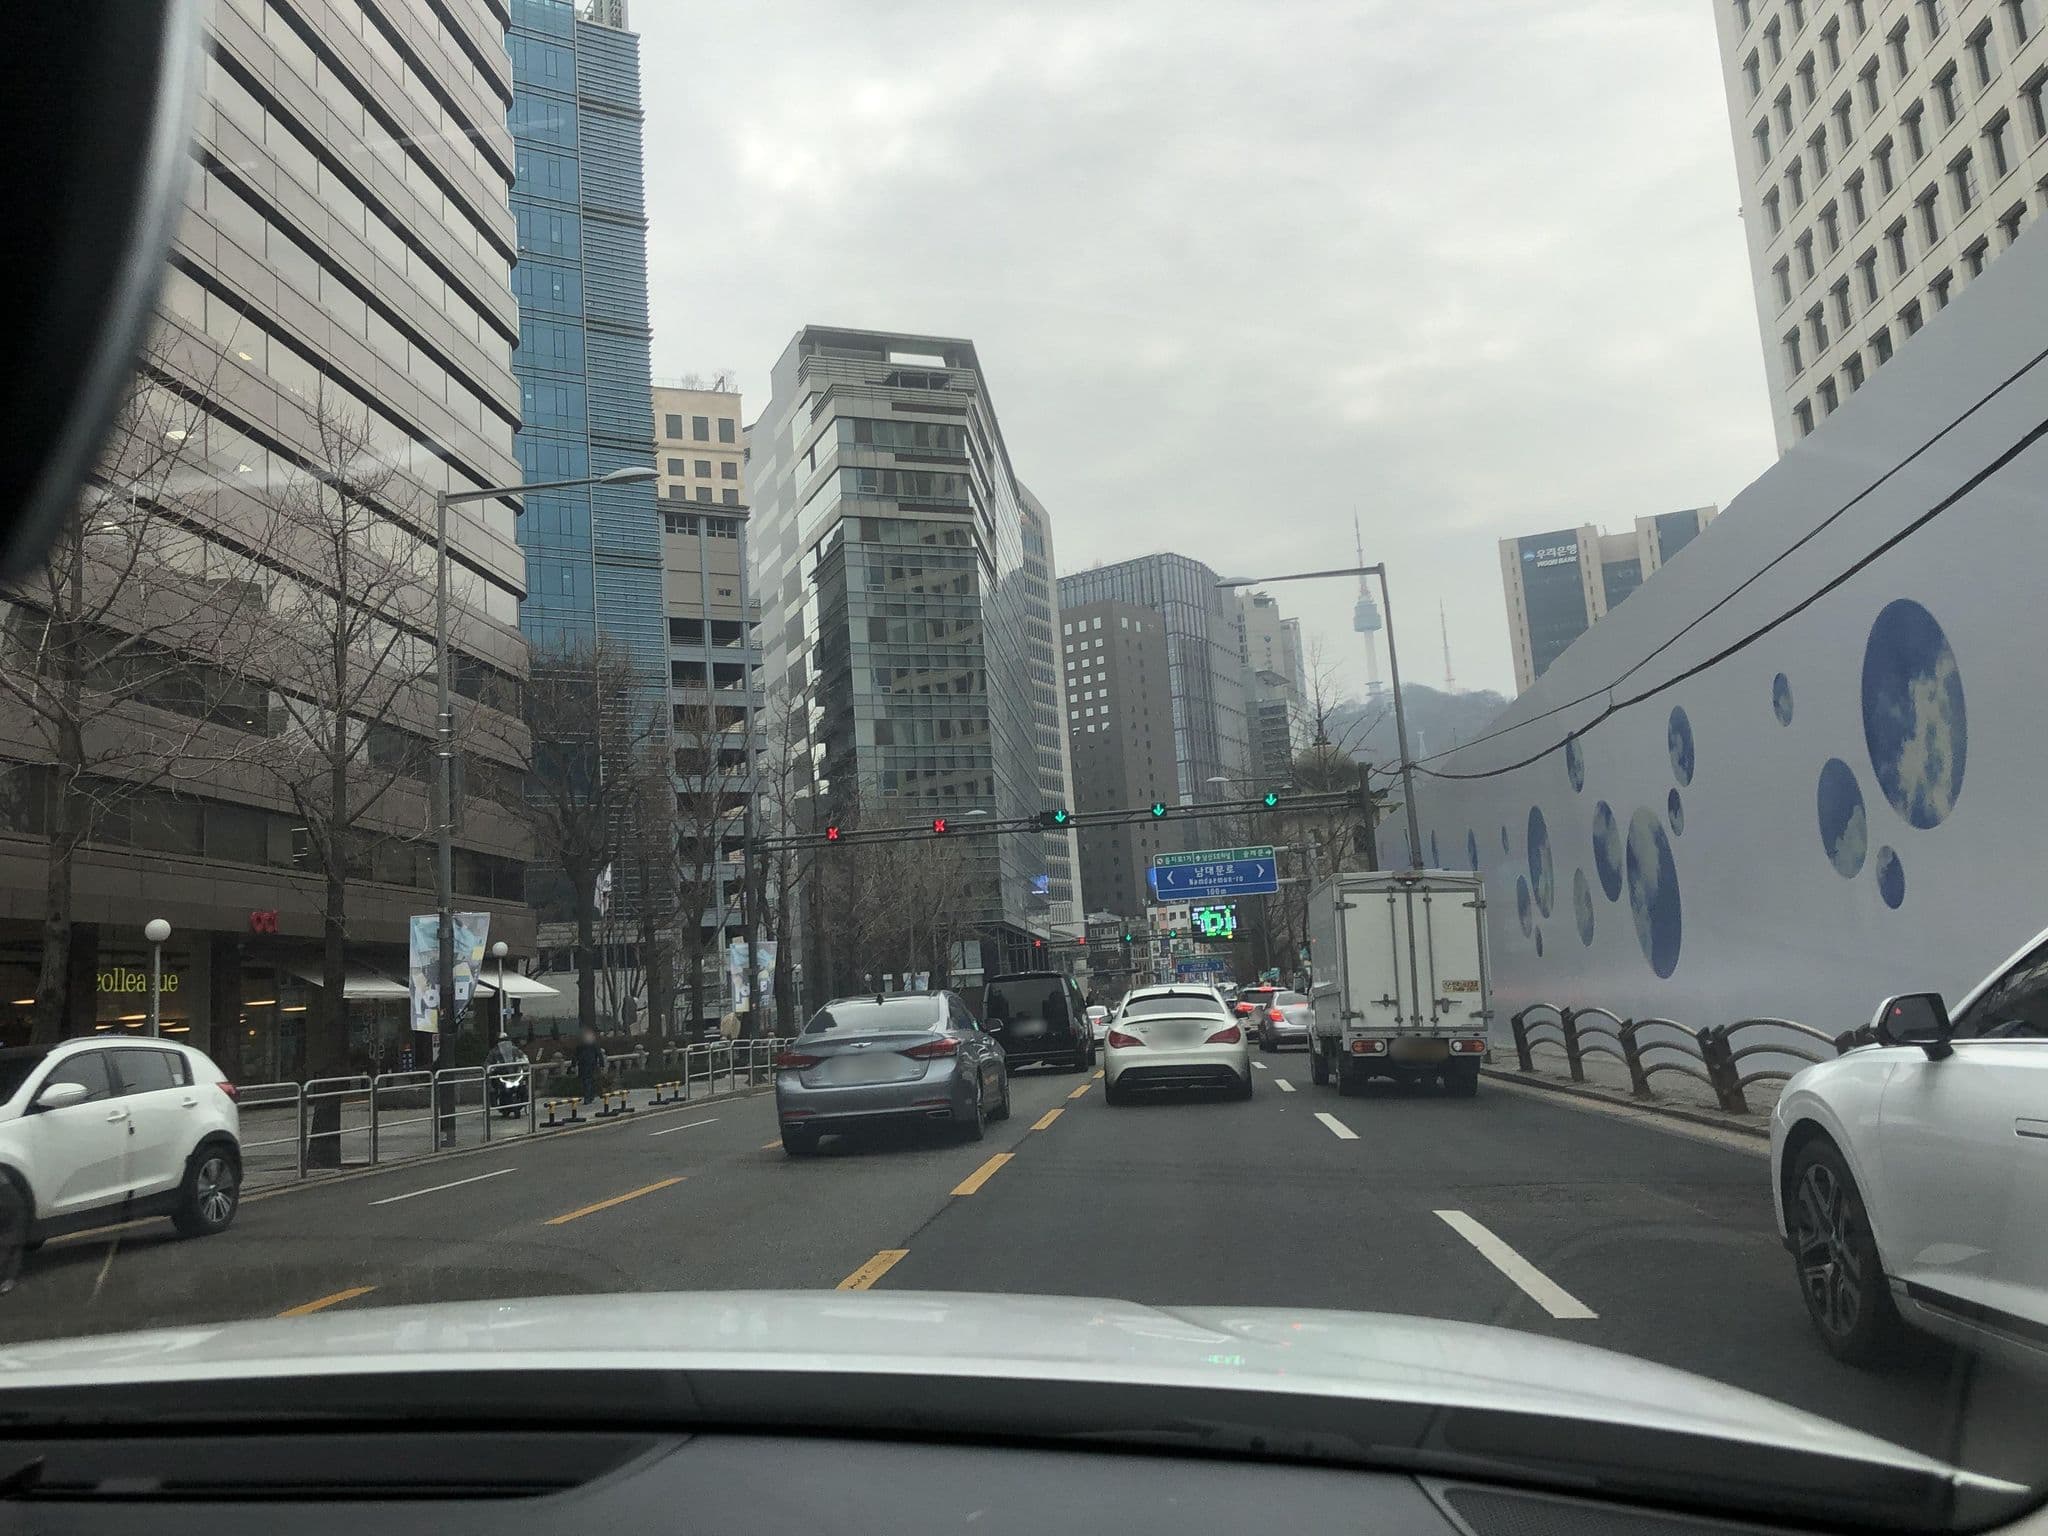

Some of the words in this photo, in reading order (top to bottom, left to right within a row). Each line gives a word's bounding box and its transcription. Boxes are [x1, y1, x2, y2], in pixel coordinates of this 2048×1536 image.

[1535, 544, 1577, 559] 우리은행
[1558, 556, 1577, 564] BANK
[1194, 864, 1236, 878] 남대문로
[1206, 887, 1227, 896] 100m
[96, 967, 179, 992] olleaue
